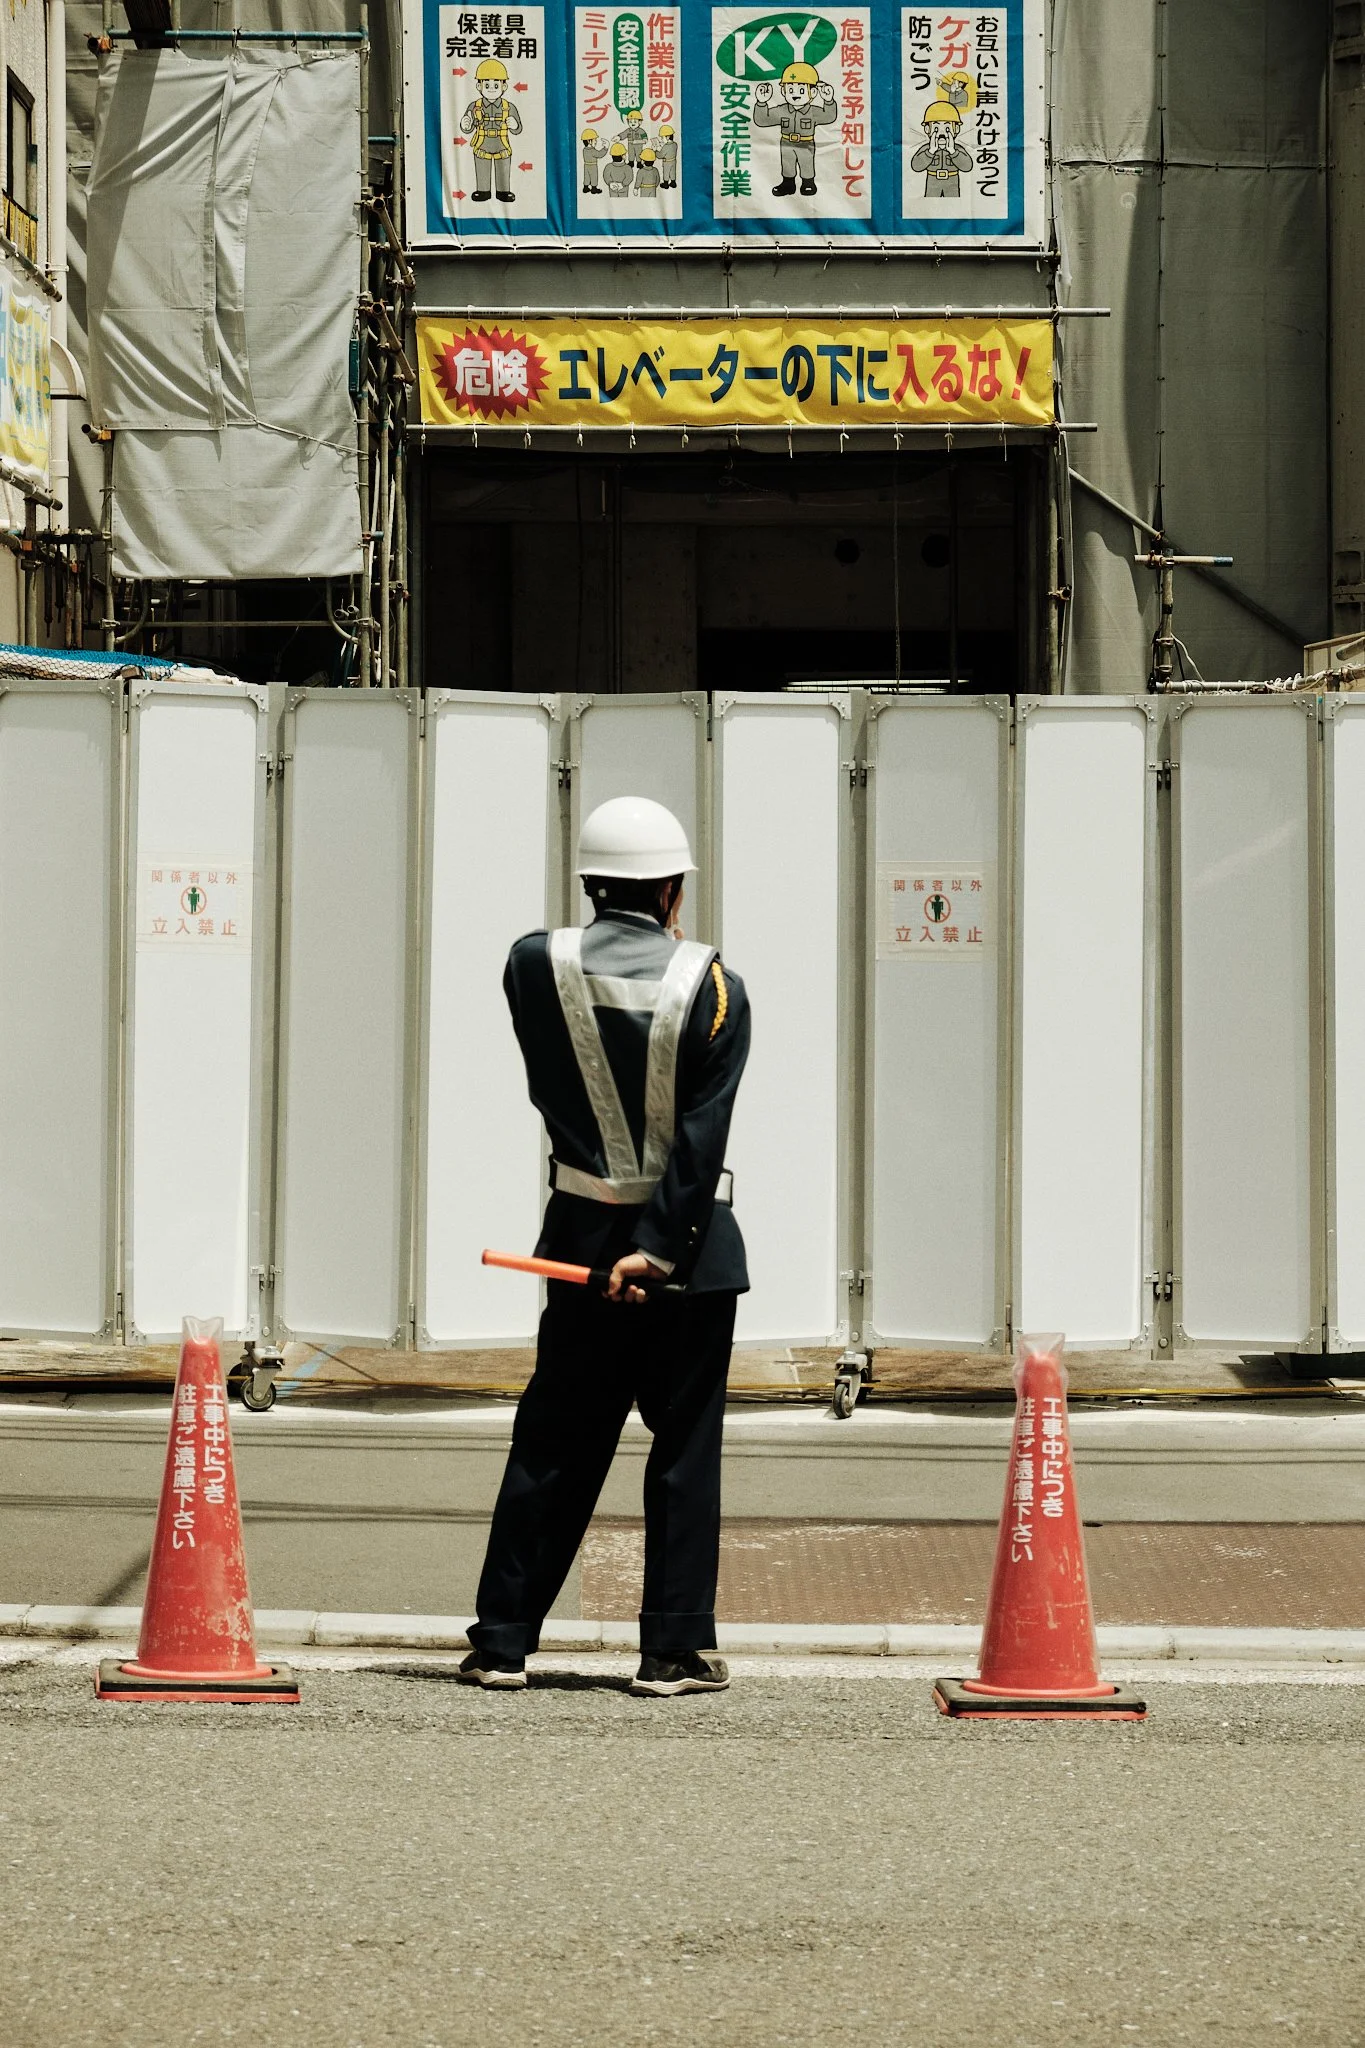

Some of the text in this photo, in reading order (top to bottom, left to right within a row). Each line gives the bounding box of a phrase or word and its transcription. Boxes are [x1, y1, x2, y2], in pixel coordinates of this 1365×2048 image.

[446, 37, 537, 59] 完全着用
[457, 13, 526, 35] 保護具
[734, 18, 822, 77] KY
[908, 15, 932, 91] 防ごう
[937, 15, 972, 69] ケガ
[582, 12, 611, 124] ミーティング
[617, 20, 640, 108] 安全確認
[647, 13, 675, 123] 作業前の
[720, 83, 752, 198] 安全作業
[840, 18, 864, 198] 危険を予知して
[975, 15, 1000, 197] お互いに声かけあって
[452, 347, 529, 398] 危険
[151, 870, 238, 885] 関係者以外
[893, 879, 982, 892] 関係者以外
[152, 917, 238, 936] 立入禁止
[895, 925, 983, 943] 立入禁止
[172, 1384, 197, 1549] 駐車ご遠慮下さい
[202, 1384, 226, 1504] 工事中につき
[1040, 1397, 1065, 1518] 工事中につき
